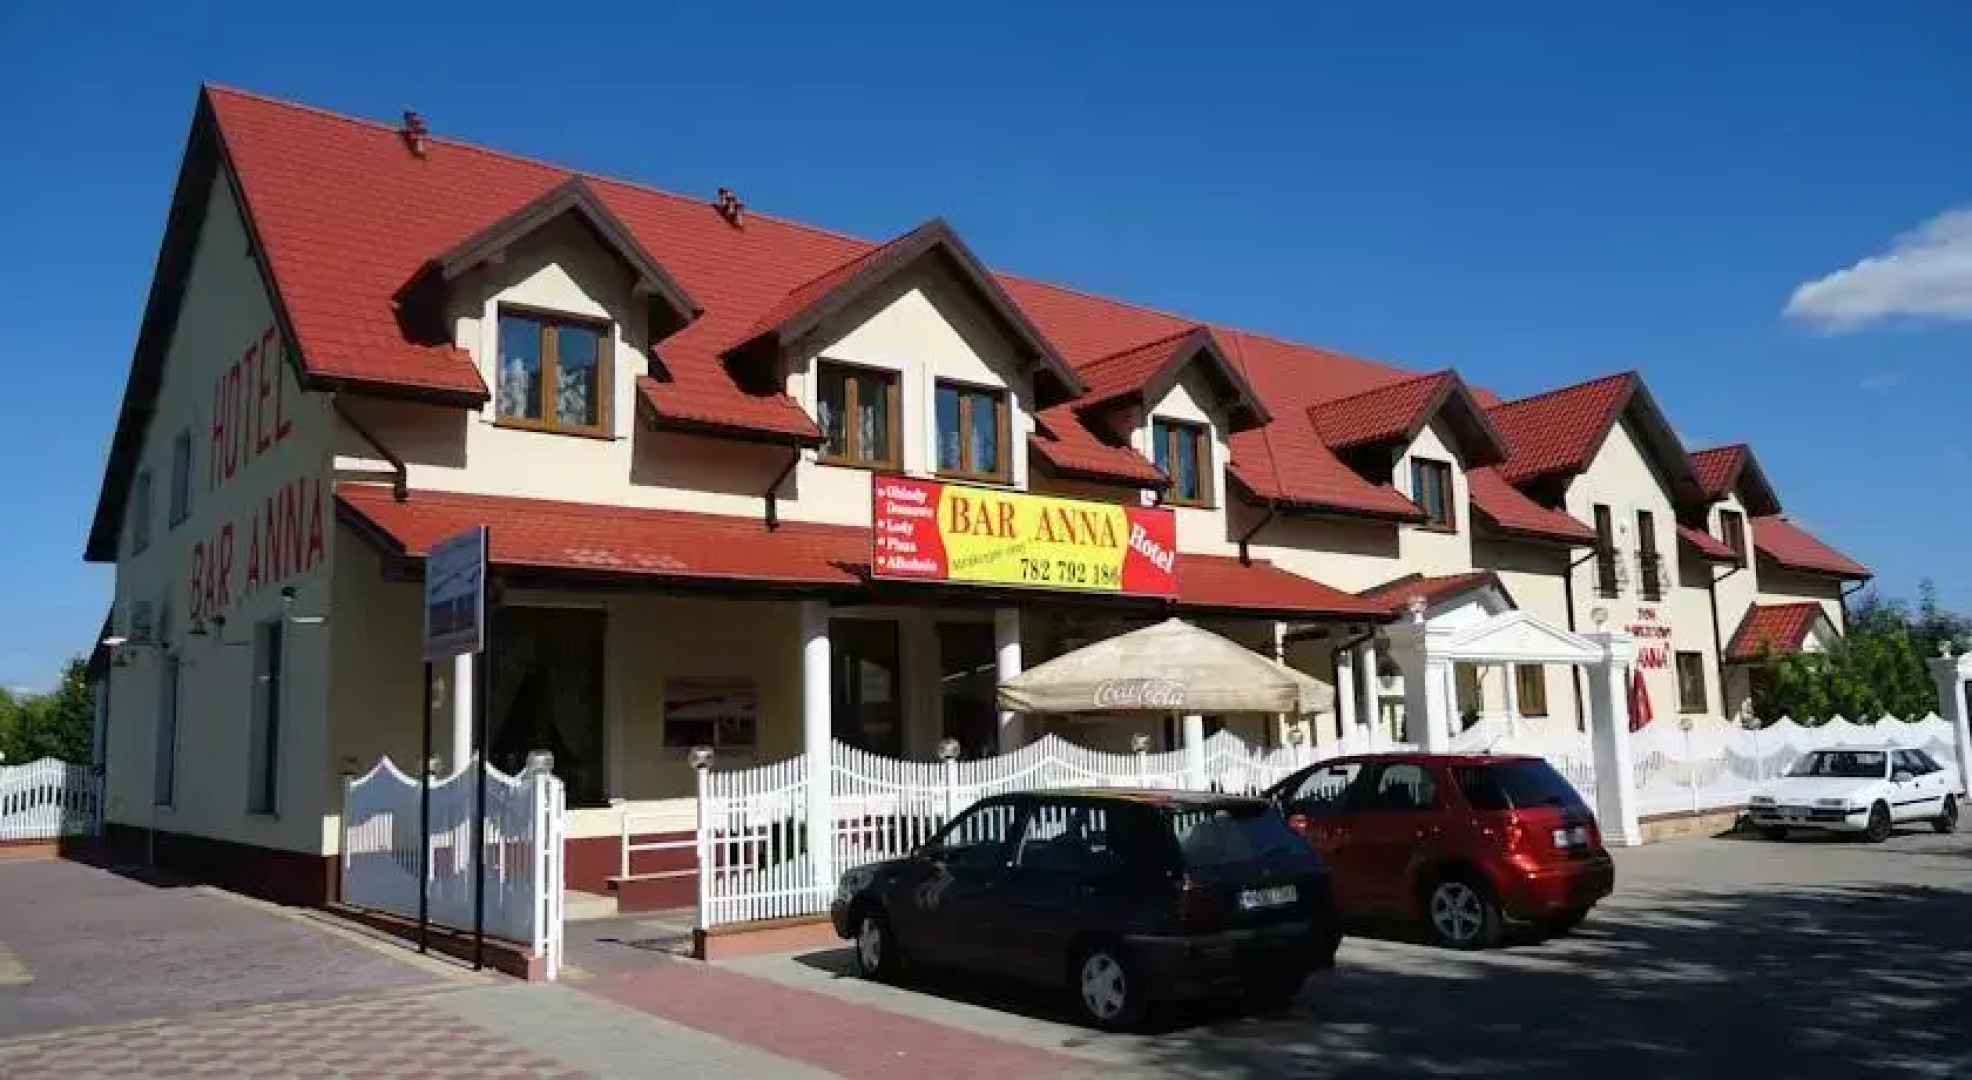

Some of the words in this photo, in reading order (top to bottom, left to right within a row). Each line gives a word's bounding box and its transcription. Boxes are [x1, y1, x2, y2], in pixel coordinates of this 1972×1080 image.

[210, 325, 292, 493] HOTEL
[189, 522, 234, 620] BAR
[247, 476, 325, 593] ANNA
[949, 497, 1016, 538] BAR
[1034, 507, 1118, 548] ANNA
[1129, 522, 1175, 574] Hotel
[1020, 558, 1050, 581] 782
[1057, 561, 1086, 583] 792
